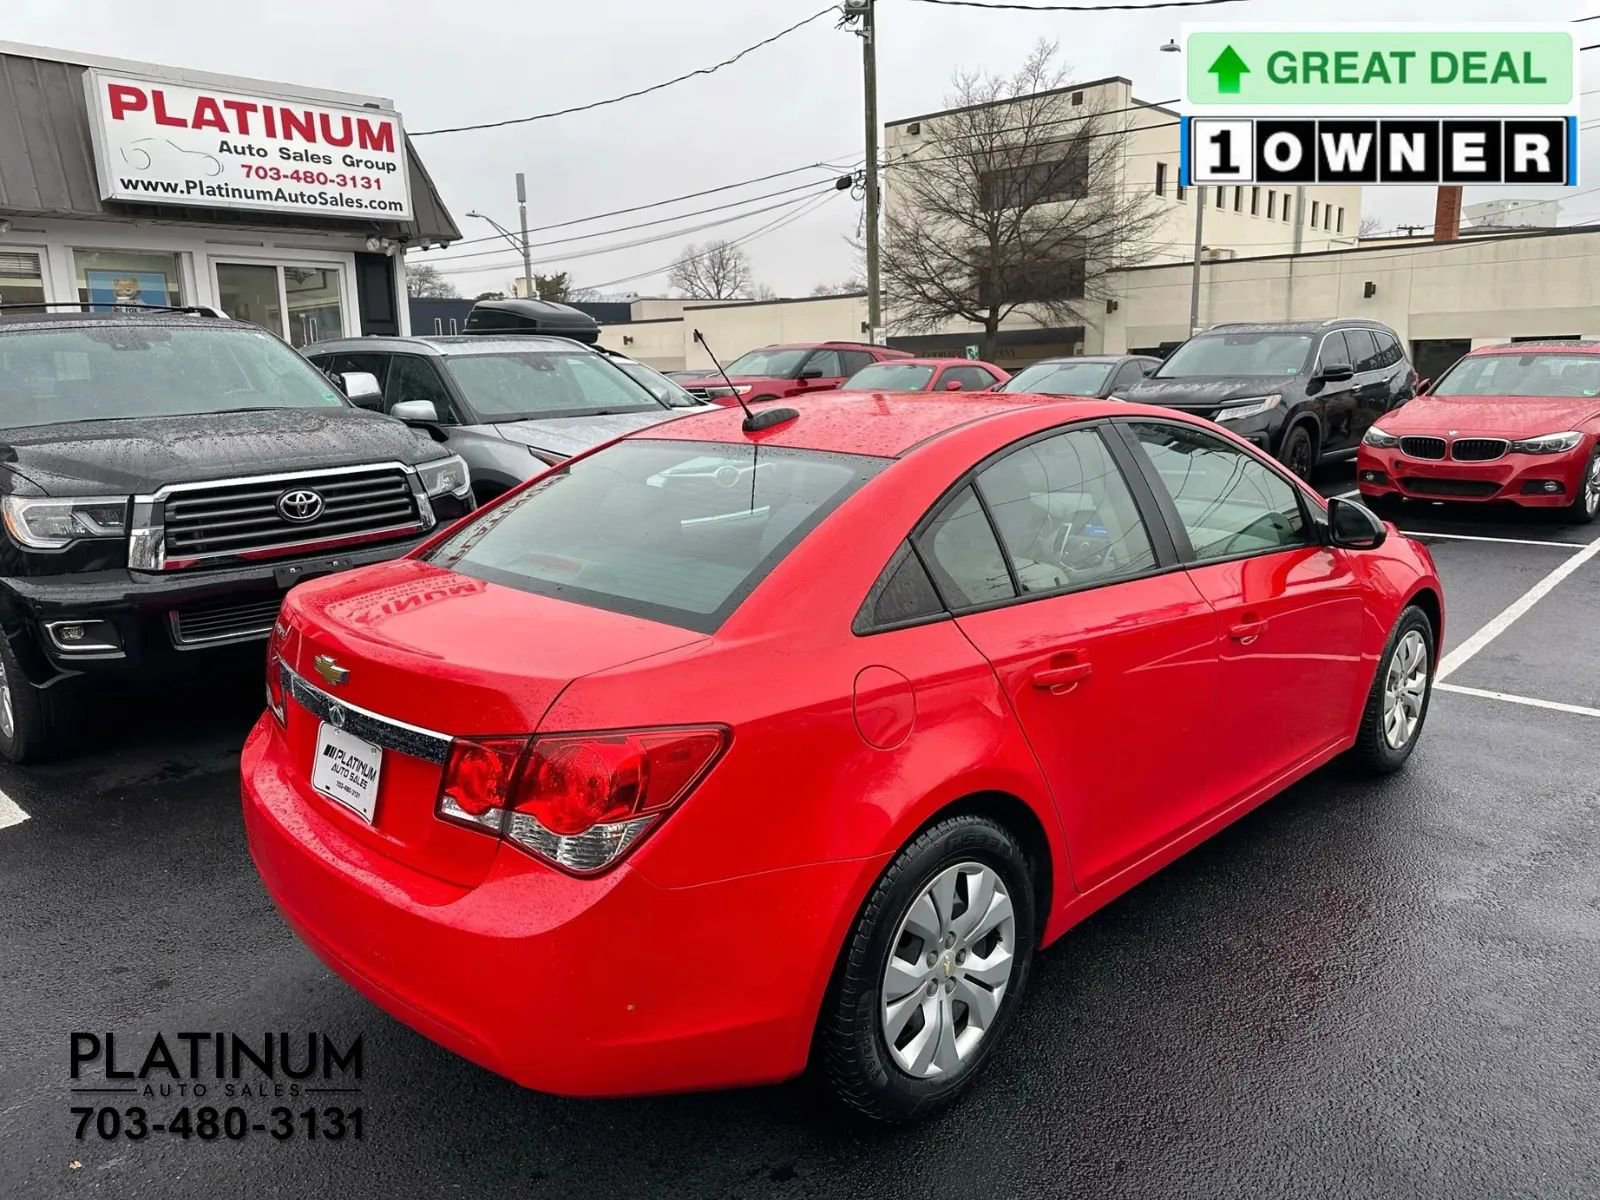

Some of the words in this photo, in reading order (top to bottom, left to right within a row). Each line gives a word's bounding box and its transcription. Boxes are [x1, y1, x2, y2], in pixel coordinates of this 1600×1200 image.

[107, 83, 395, 153] PLATINUM
[218, 140, 268, 158] Auto
[279, 146, 333, 165] Sales
[342, 154, 397, 174] Group
[120, 177, 403, 212] www.PlatinumAutoSales.com
[240, 164, 382, 191] 703-480-3131
[331, 763, 350, 778] AUTO
[349, 772, 368, 790] SALES
[335, 748, 377, 782] PLATINUM
